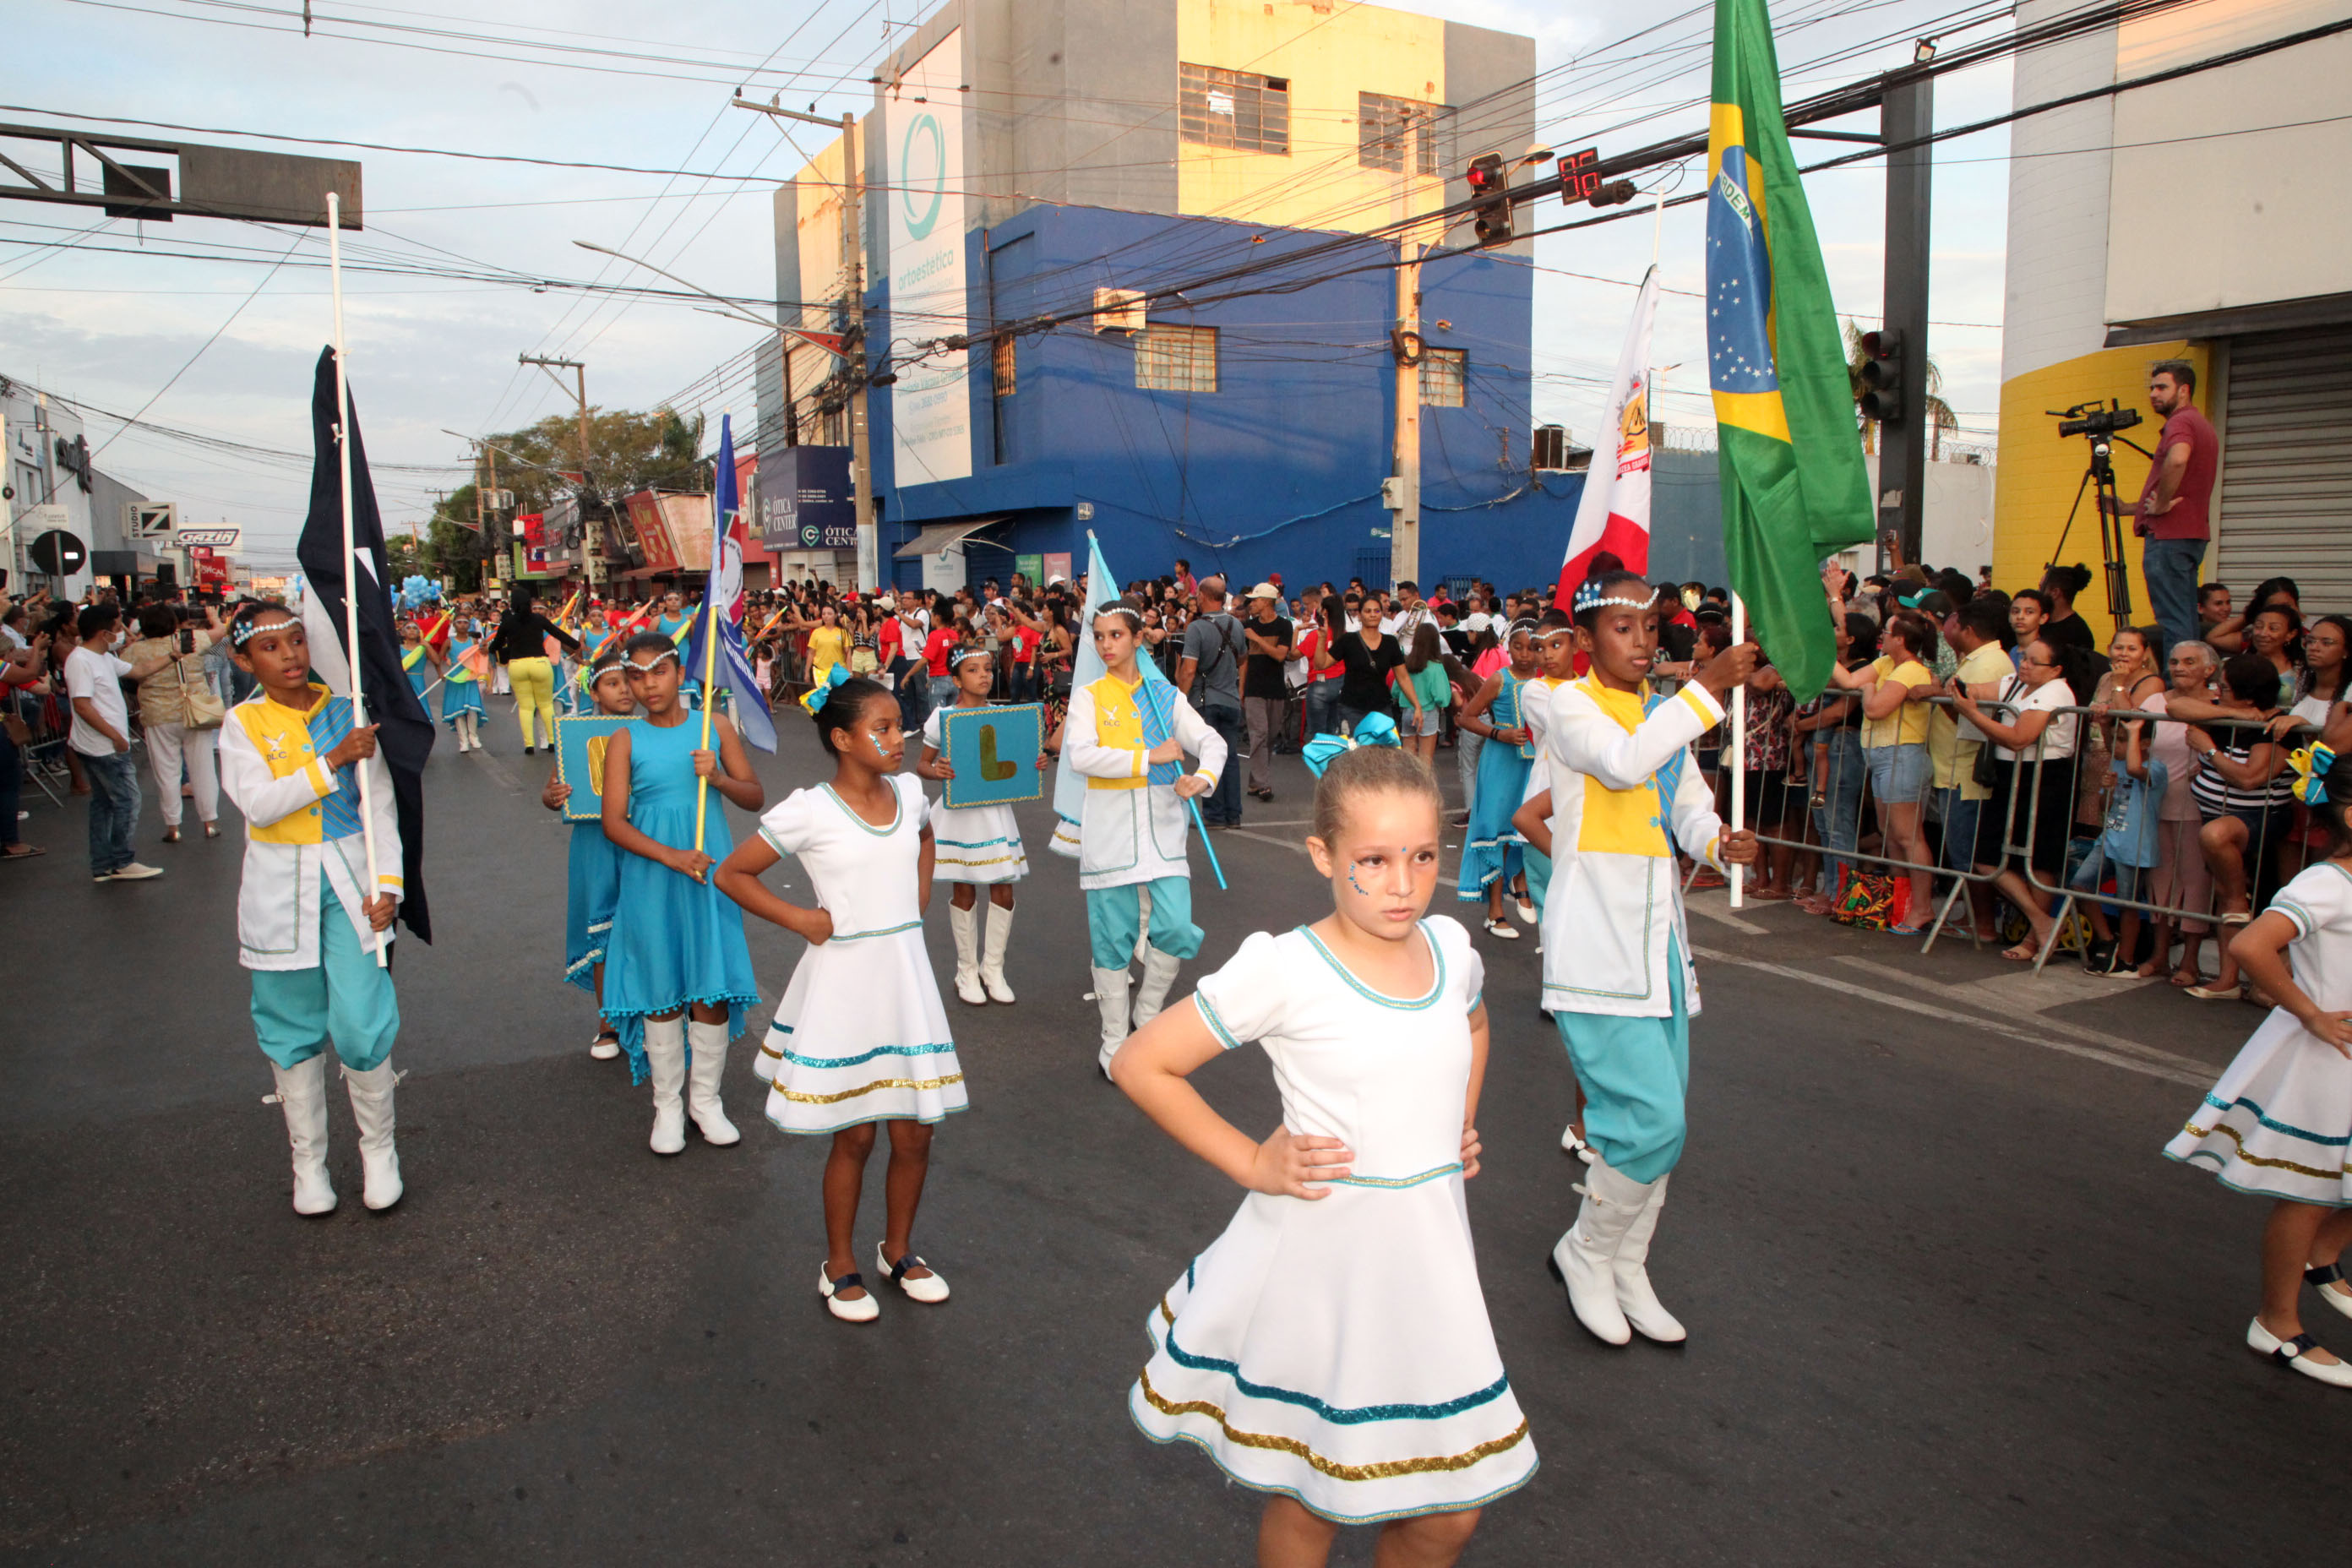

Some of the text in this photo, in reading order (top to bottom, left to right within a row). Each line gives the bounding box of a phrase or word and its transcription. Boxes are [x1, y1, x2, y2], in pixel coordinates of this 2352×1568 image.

[1721, 176, 1751, 220] RDEM
[773, 495, 792, 514] ÓTICA
[131, 506, 139, 538] STUDIO
[774, 513, 798, 532] CENTER
[178, 530, 237, 543] GAZIN
[825, 536, 857, 546] CENT
[979, 724, 1017, 781] L
